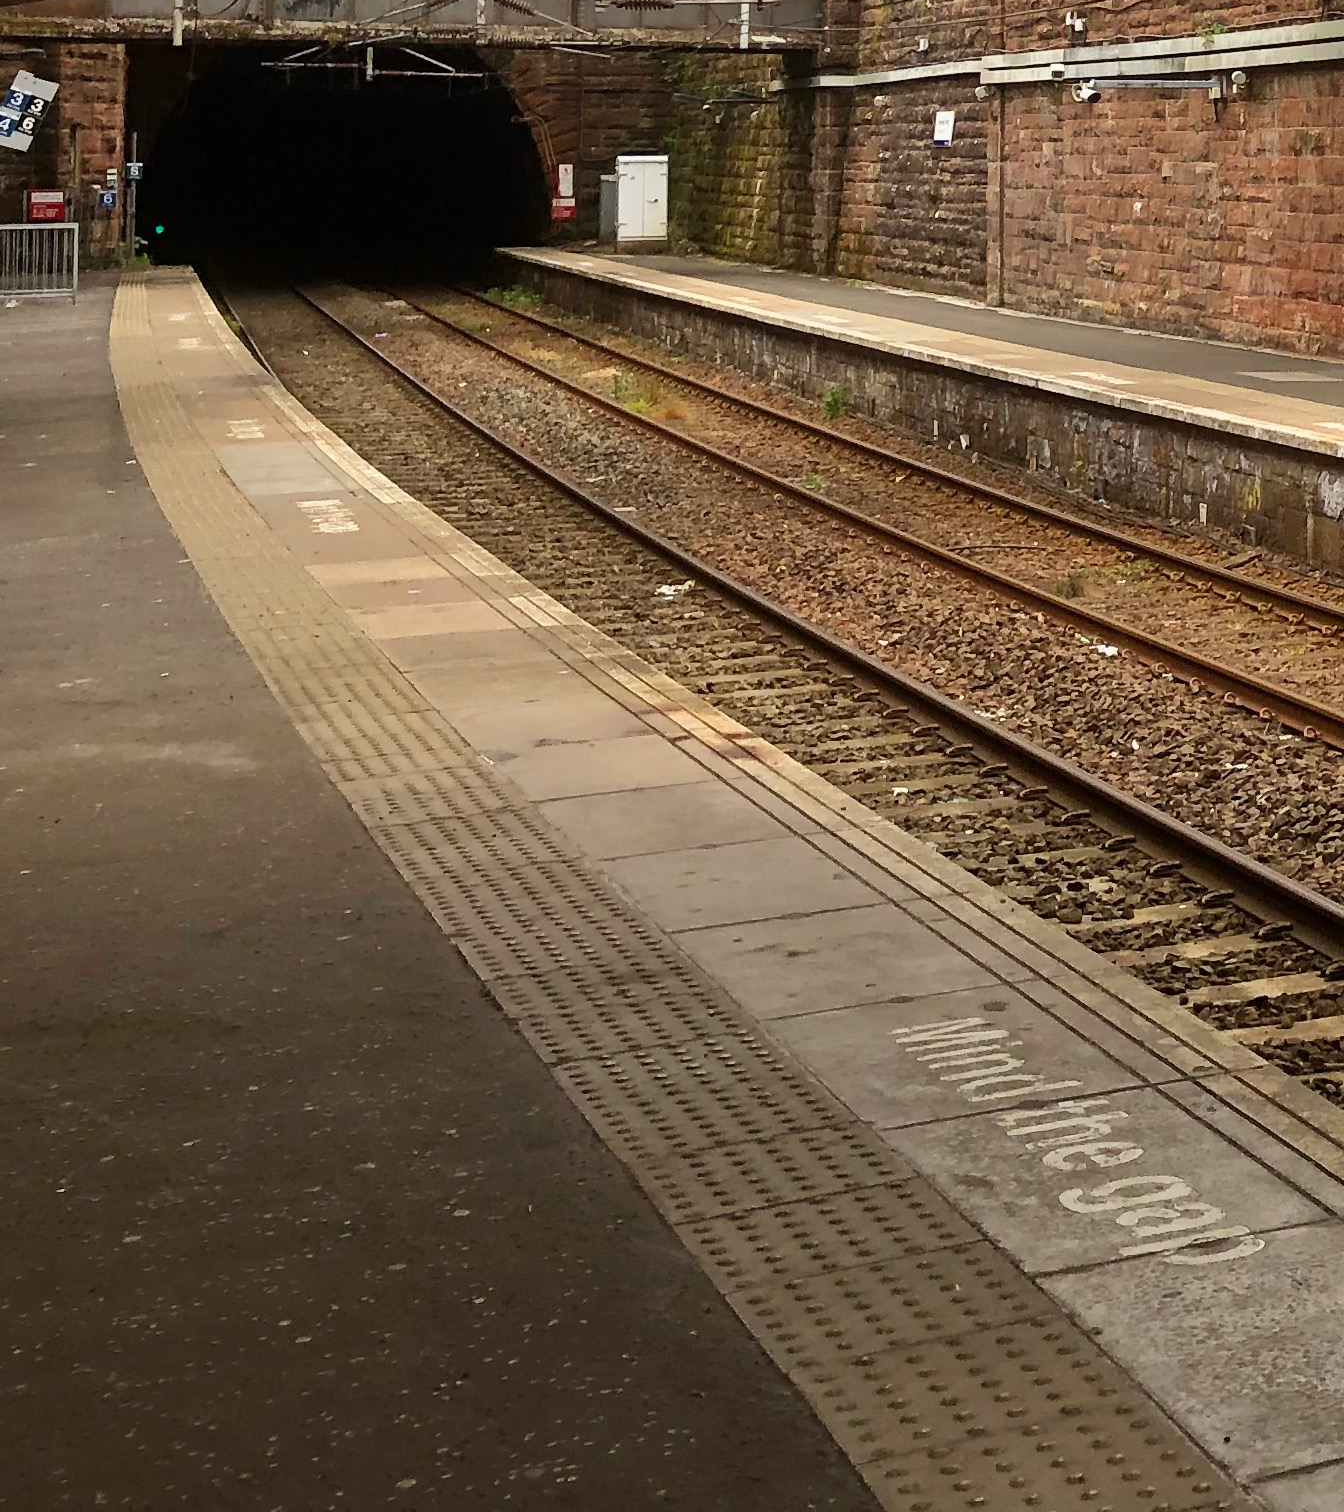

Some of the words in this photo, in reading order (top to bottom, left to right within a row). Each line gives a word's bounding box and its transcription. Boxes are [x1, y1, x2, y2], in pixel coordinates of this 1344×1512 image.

[10, 92, 24, 106] 3
[30, 98, 45, 112] 3
[22, 117, 36, 130] 6
[890, 1016, 1084, 1102] Mind
[996, 1098, 1145, 1172] the
[1058, 1174, 1267, 1266] gap
